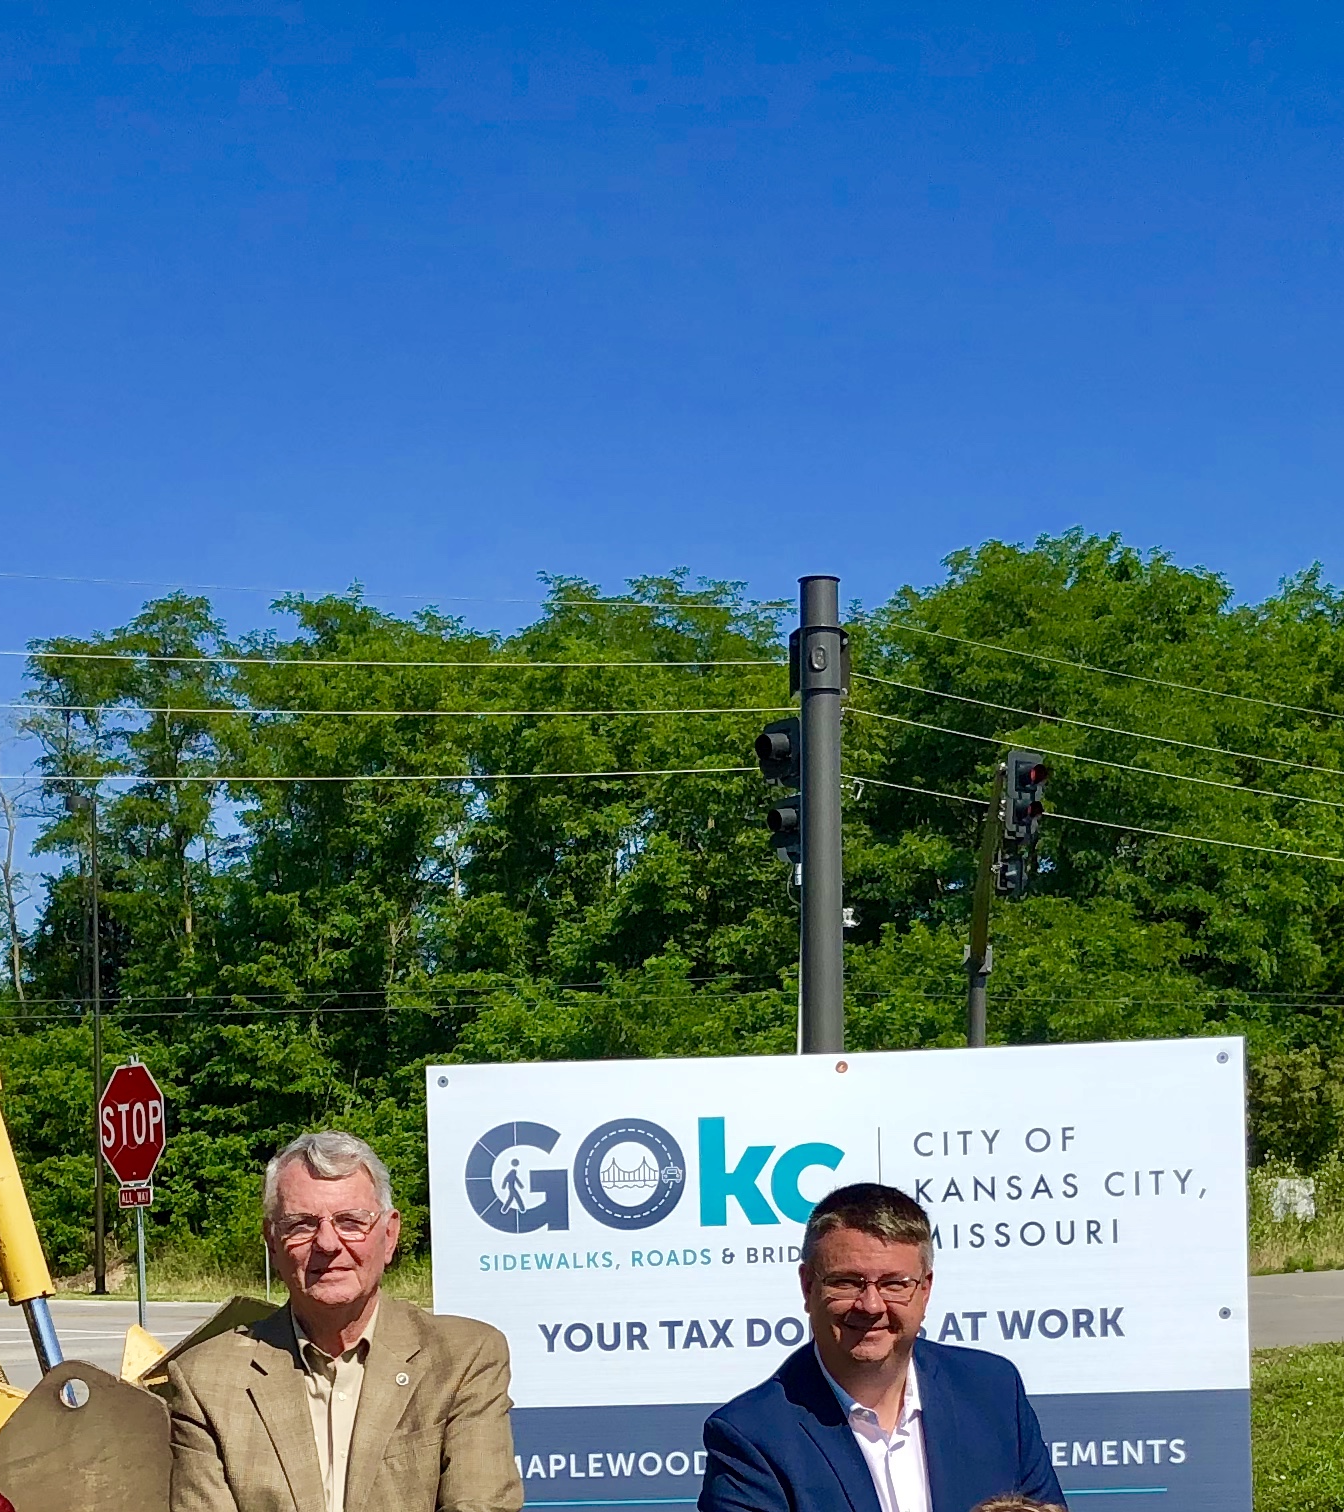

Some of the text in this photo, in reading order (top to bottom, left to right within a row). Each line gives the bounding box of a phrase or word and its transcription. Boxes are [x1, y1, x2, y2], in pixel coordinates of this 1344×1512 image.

[102, 1099, 163, 1148] STOP
[913, 1126, 1075, 1157] CITY OF
[121, 1190, 149, 1204] ALL WAY
[914, 1168, 1207, 1203] KANSAS CITY,
[479, 1250, 622, 1272] SIDEWALKS,
[630, 1247, 713, 1268] ROADS
[721, 1245, 736, 1265] &
[538, 1321, 650, 1353] YOUR
[658, 1318, 735, 1350] TAX
[937, 1310, 988, 1342] AT
[996, 1306, 1126, 1341] WORK
[1045, 1438, 1187, 1467] EMENTS
